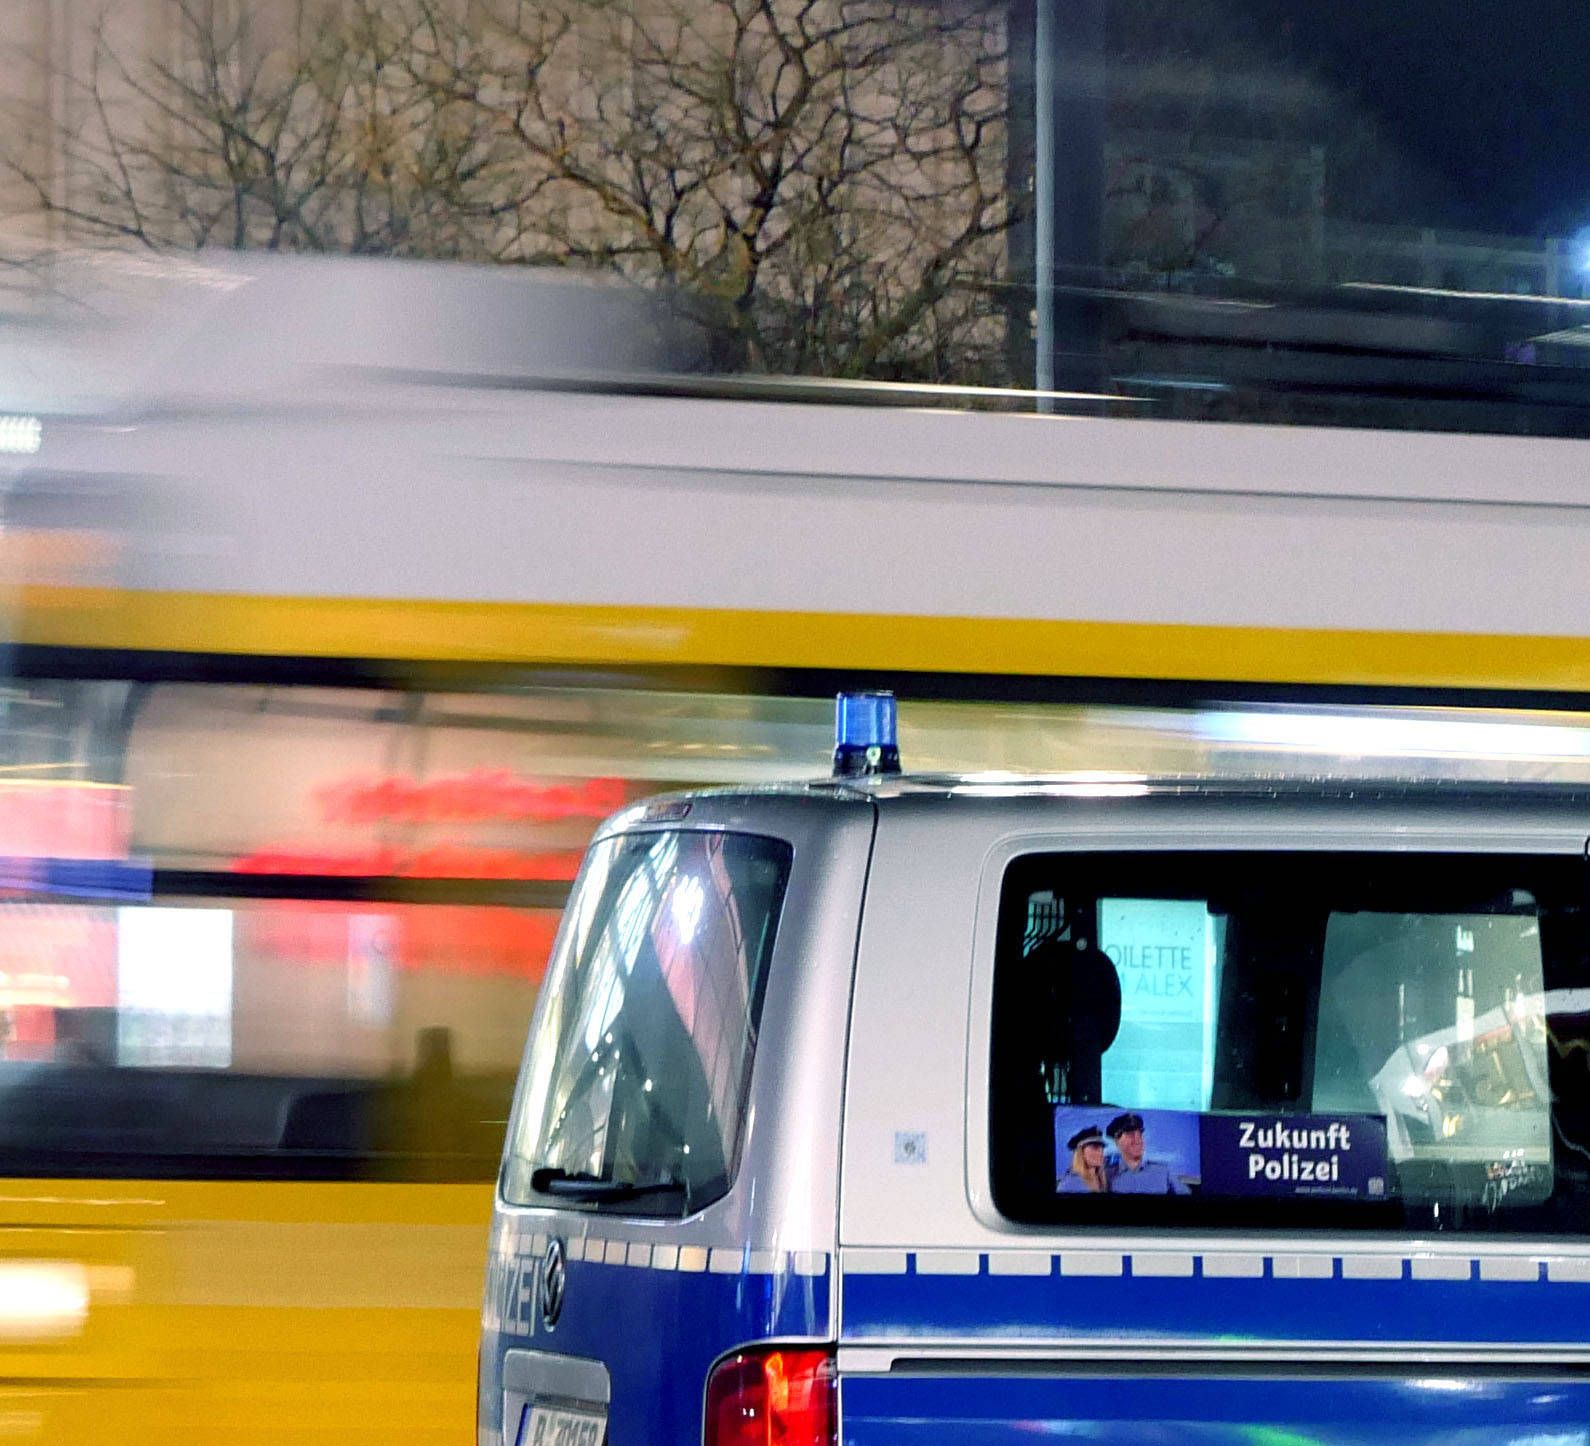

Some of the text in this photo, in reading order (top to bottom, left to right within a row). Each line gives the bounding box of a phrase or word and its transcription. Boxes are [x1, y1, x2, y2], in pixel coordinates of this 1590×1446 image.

[1104, 944, 1193, 970] OILETTE
[1134, 972, 1194, 998] ALEX
[1239, 1121, 1351, 1150] Zukunft
[1248, 1153, 1339, 1181] Polizei
